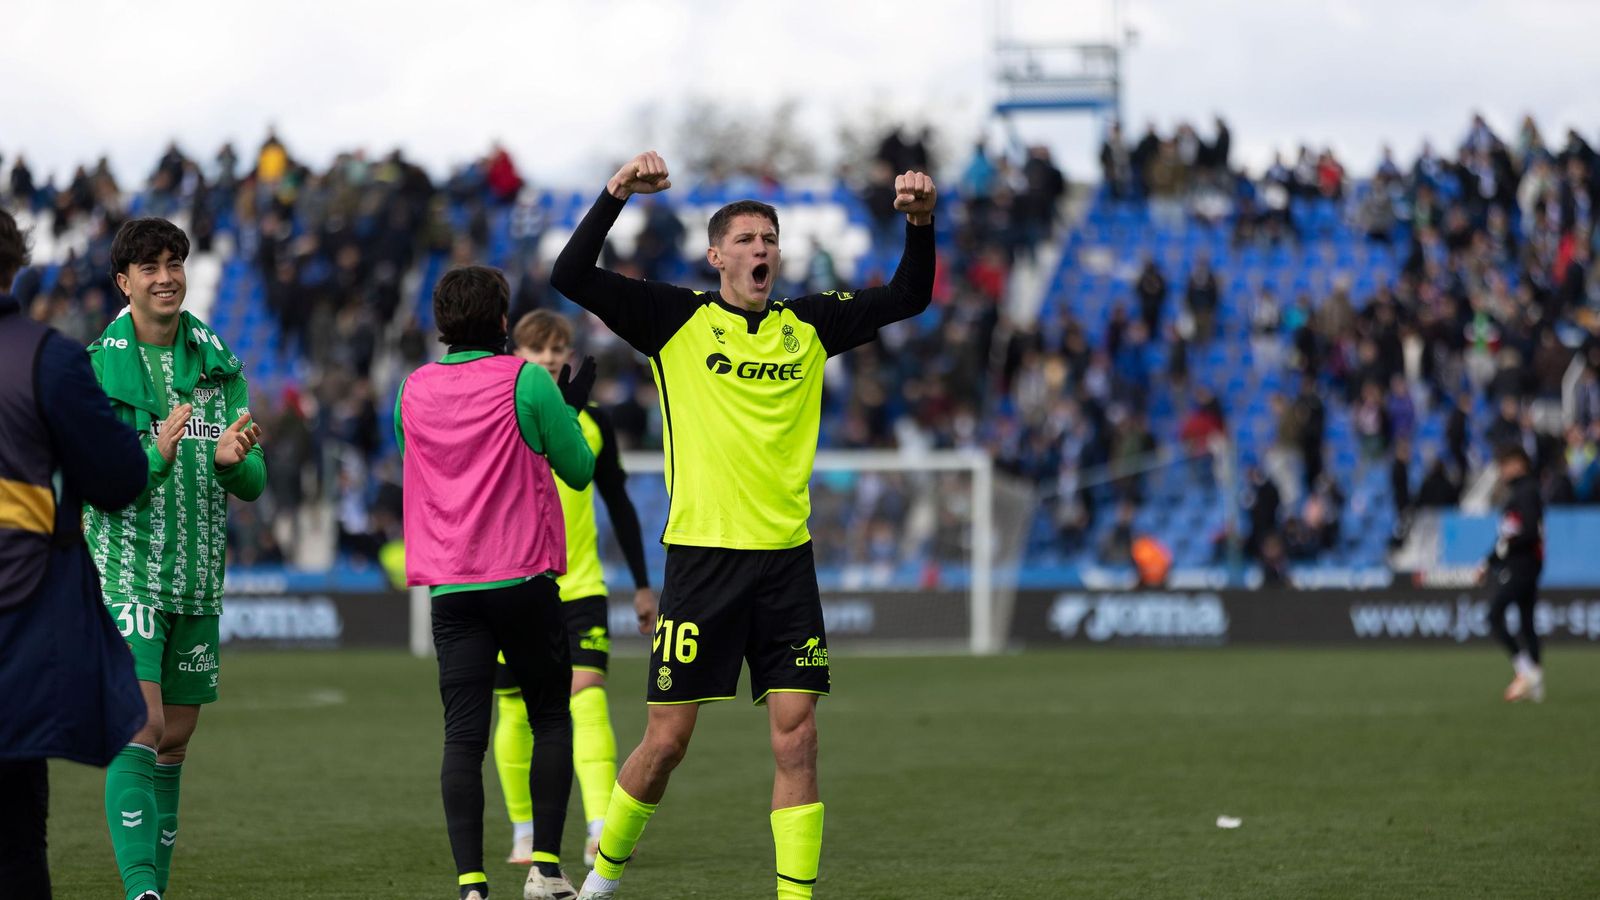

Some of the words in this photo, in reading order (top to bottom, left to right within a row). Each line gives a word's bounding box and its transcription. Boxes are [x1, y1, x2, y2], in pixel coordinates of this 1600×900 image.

[737, 361, 803, 381] GREE
[151, 418, 220, 439] tnline
[111, 603, 156, 640] 30
[662, 619, 700, 664] 16
[198, 652, 215, 663] AUS
[812, 648, 828, 658] AUS
[178, 660, 219, 673] GLOBAL
[795, 657, 829, 667] GLOBA
